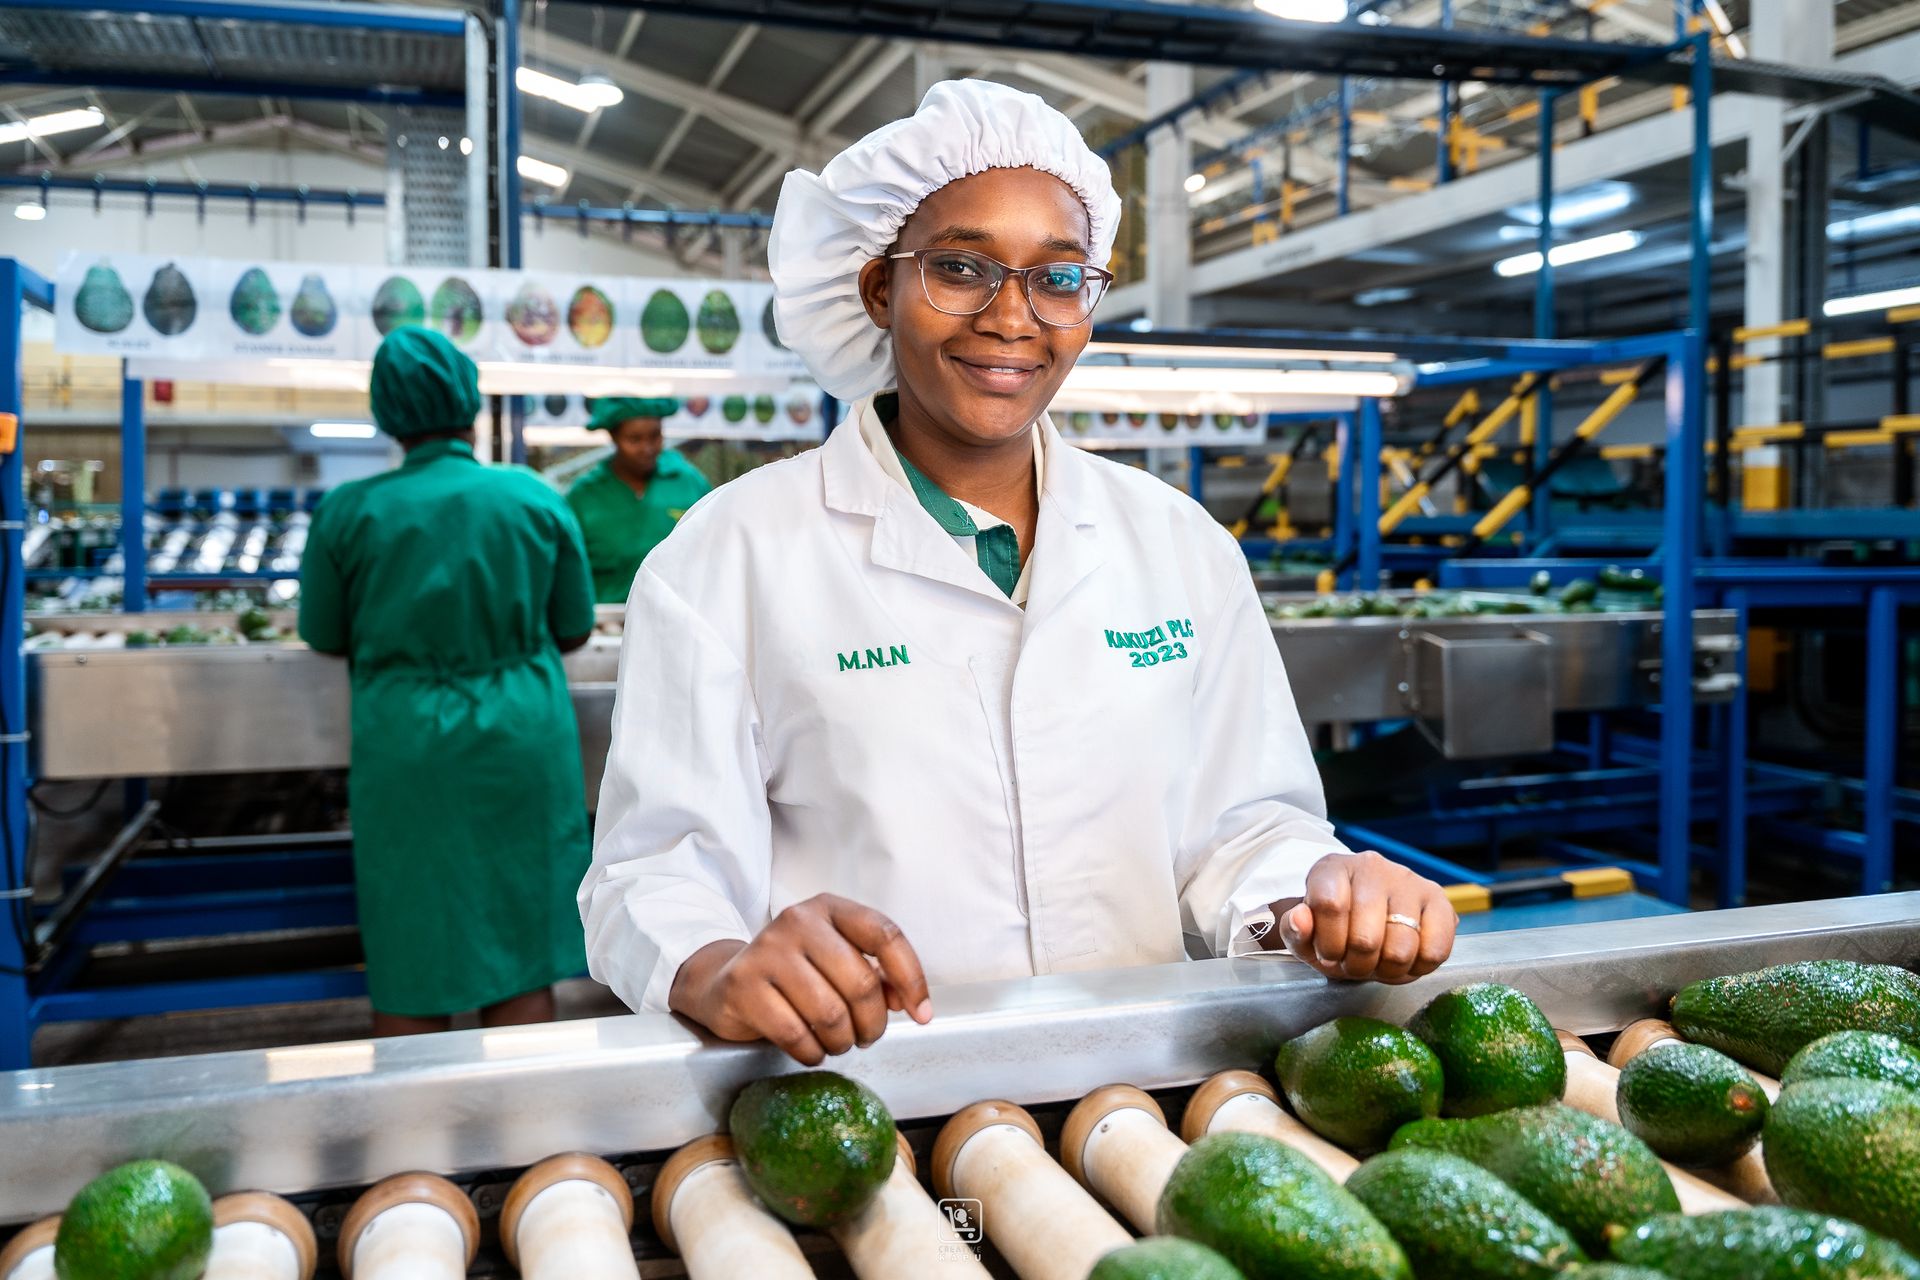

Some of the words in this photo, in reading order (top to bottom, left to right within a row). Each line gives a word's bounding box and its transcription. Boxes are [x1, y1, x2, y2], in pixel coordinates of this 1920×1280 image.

[1104, 626, 1167, 649] KAKUZI
[1166, 618, 1194, 638] PLC
[837, 644, 911, 671] M.N.N
[1129, 642, 1188, 667] 2023
